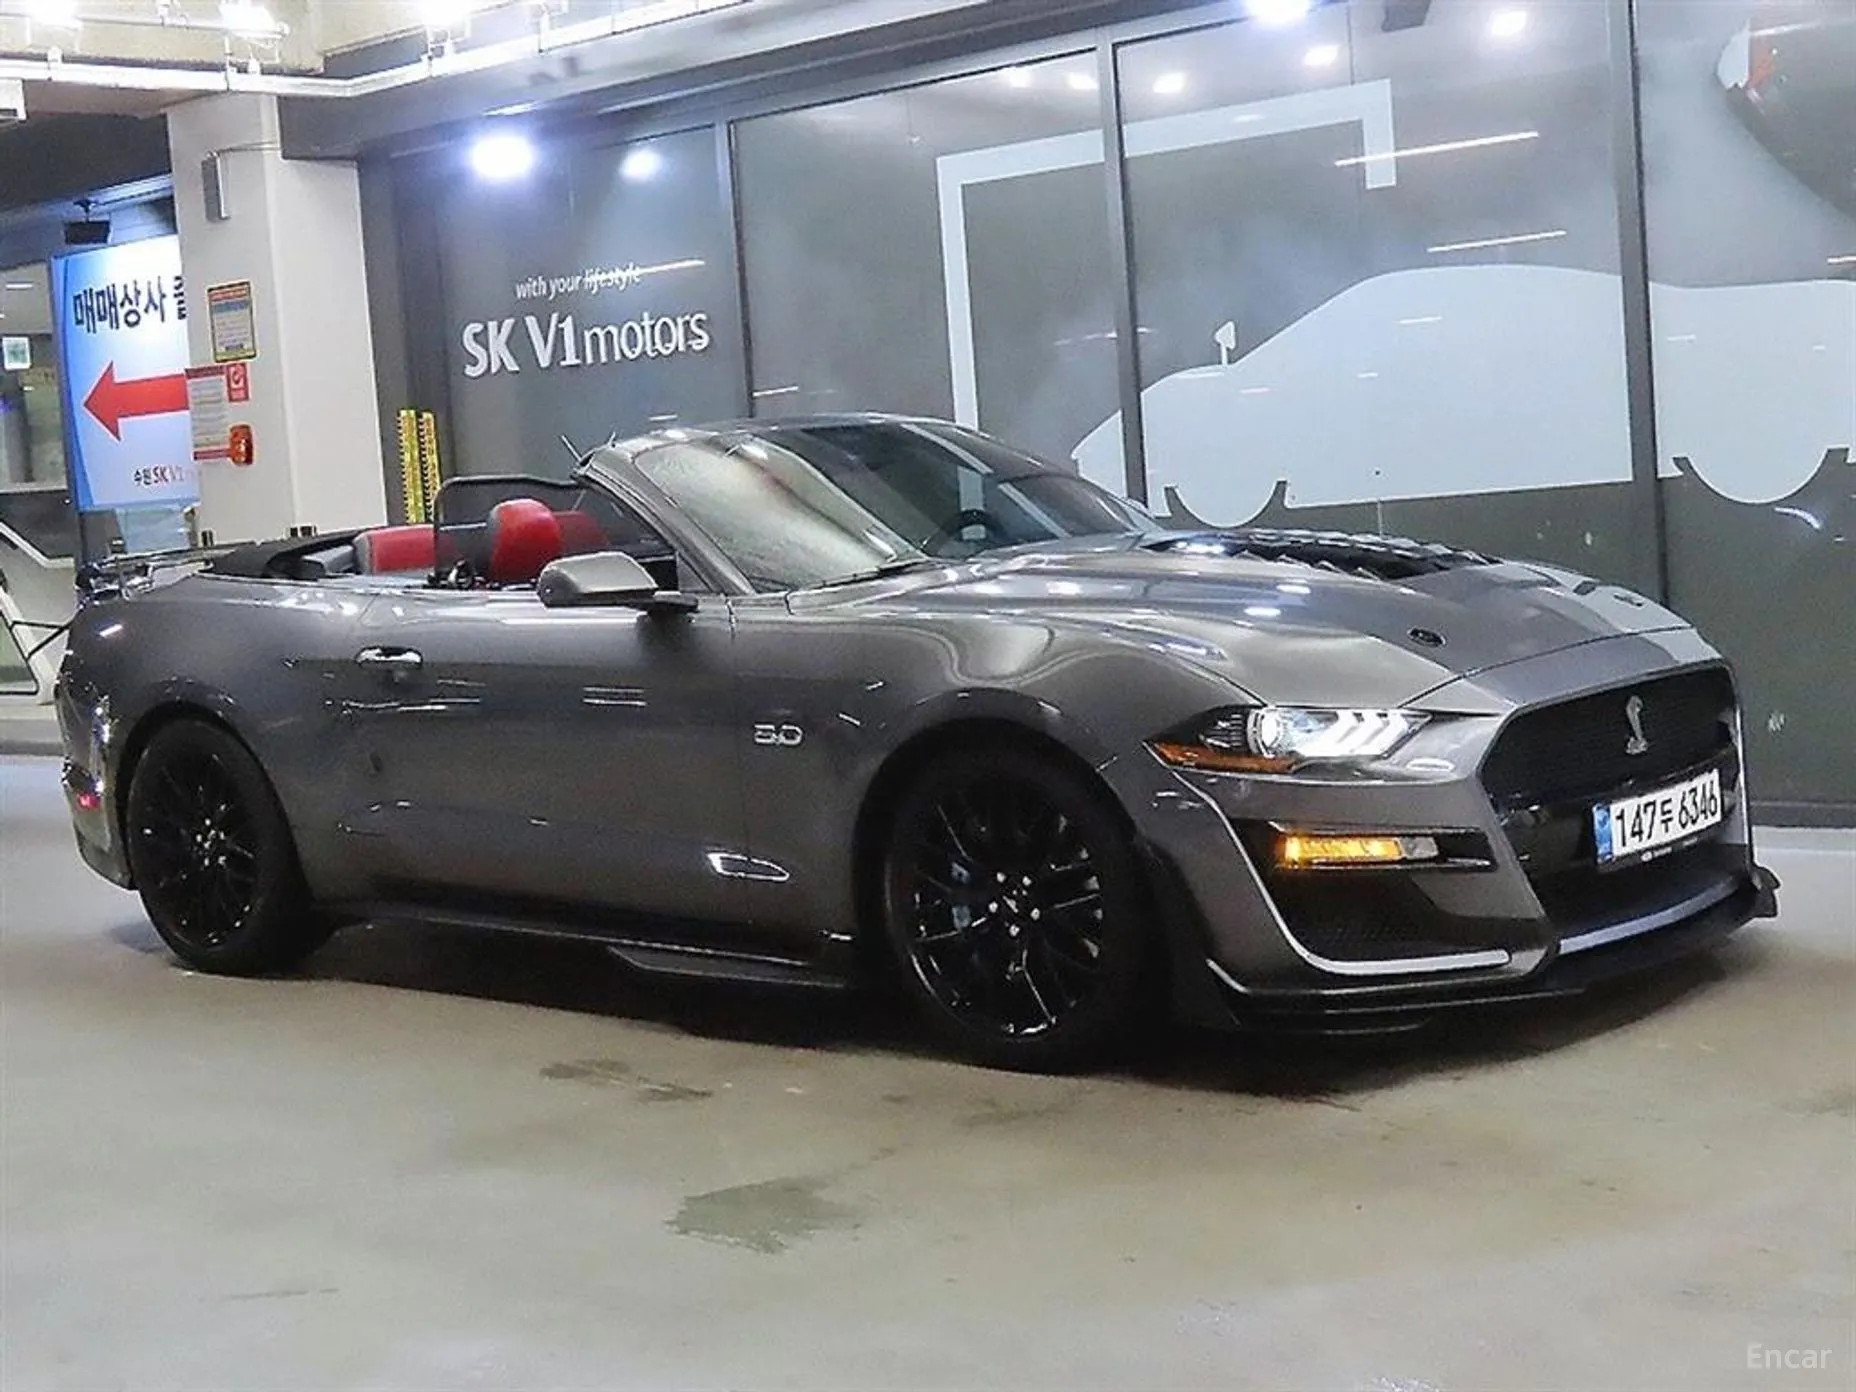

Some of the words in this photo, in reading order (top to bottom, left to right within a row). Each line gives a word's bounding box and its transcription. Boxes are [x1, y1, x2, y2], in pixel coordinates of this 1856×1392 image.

[73, 276, 167, 334] 매매상사
[516, 275, 547, 299] with
[548, 275, 582, 300] your
[584, 262, 641, 294] lifestyle
[462, 317, 520, 378] SK
